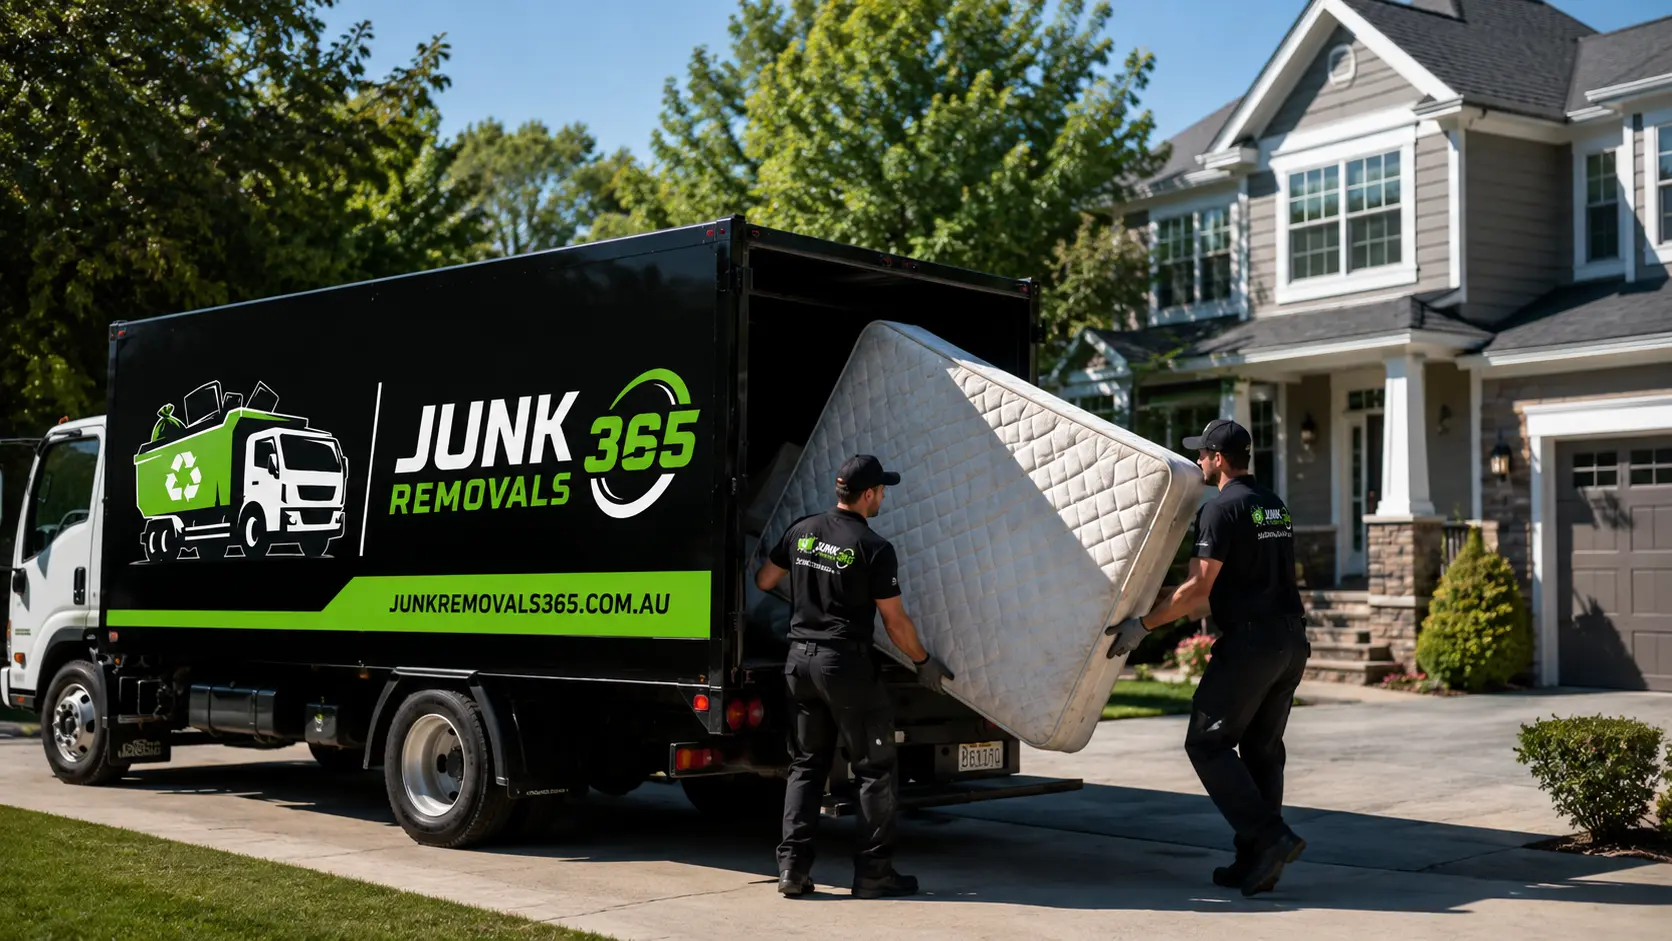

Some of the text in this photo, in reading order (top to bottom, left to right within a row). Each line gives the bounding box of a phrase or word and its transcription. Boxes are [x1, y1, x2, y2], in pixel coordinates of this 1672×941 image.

[394, 391, 701, 474] JUNK 365
[389, 472, 571, 515] REMOVALS
[389, 593, 671, 615] JUNKREMOVALS365.COM.AU
